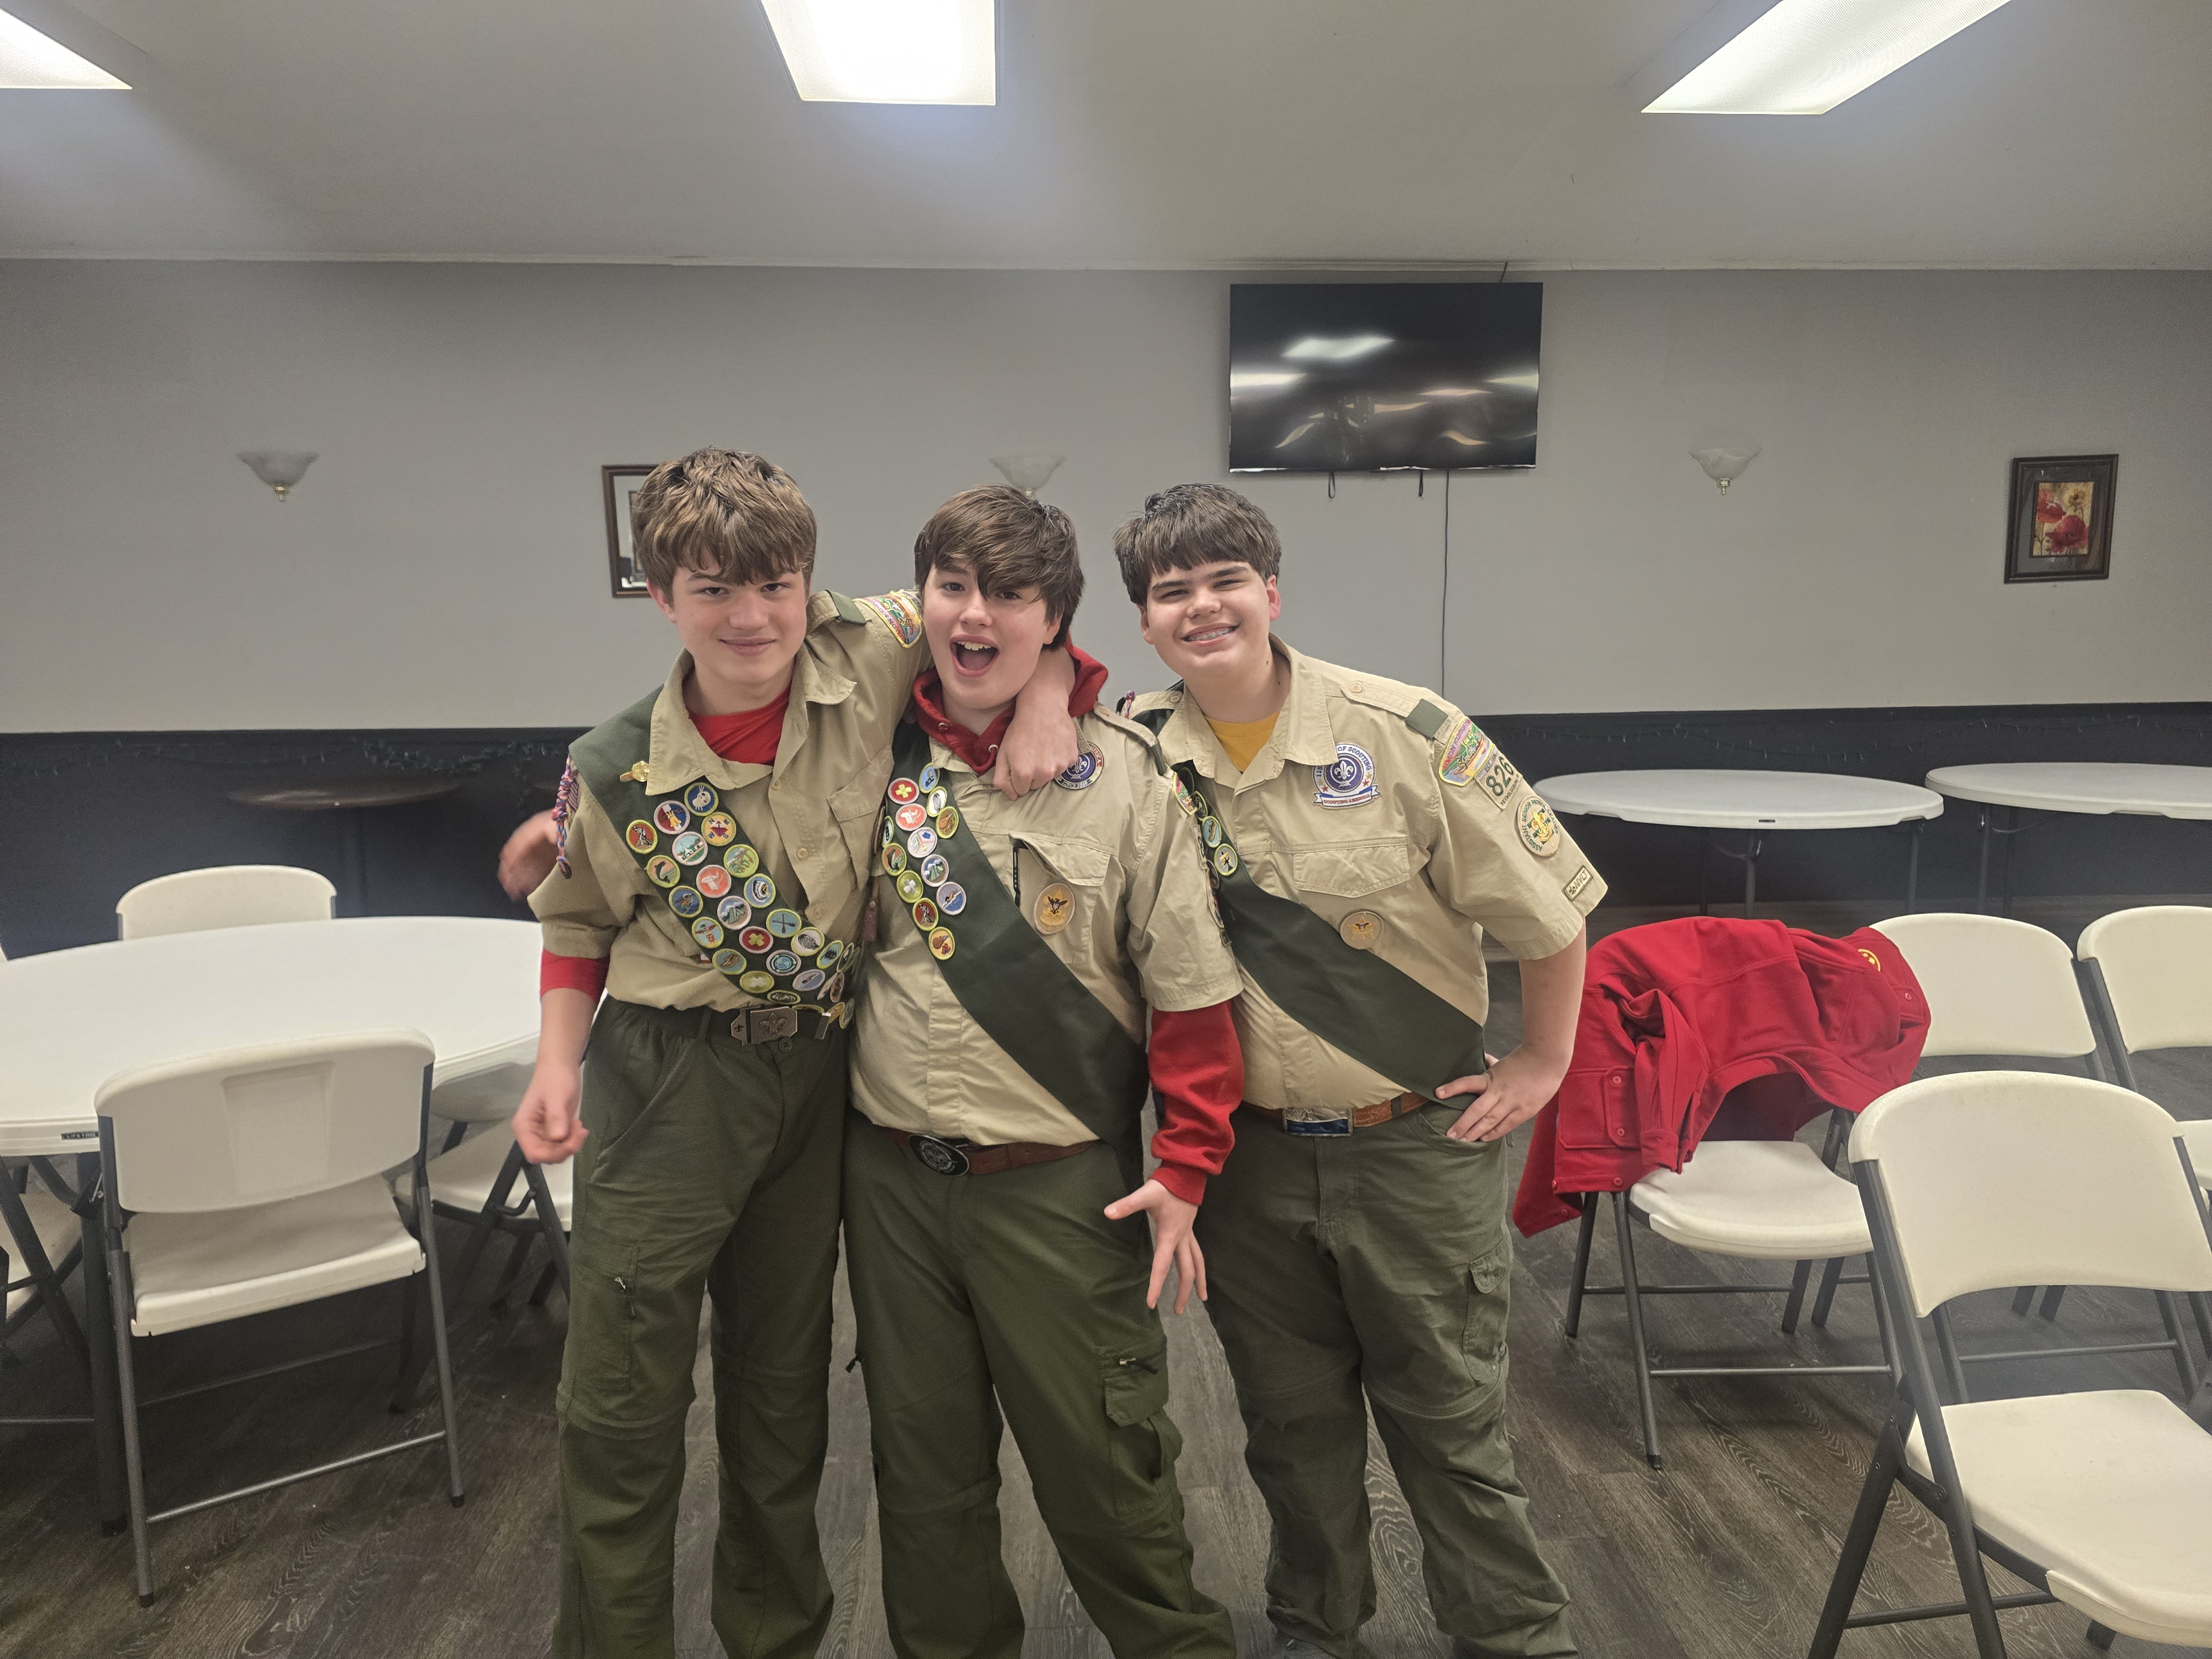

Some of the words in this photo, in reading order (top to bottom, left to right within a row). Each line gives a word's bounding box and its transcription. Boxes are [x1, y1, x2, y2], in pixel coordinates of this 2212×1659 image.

[1348, 747, 1372, 770] SCOUTING
[1486, 756, 1514, 797] 826
[1521, 801, 1532, 822] SENIOR
[1522, 824, 1543, 852] ASSISTANT
